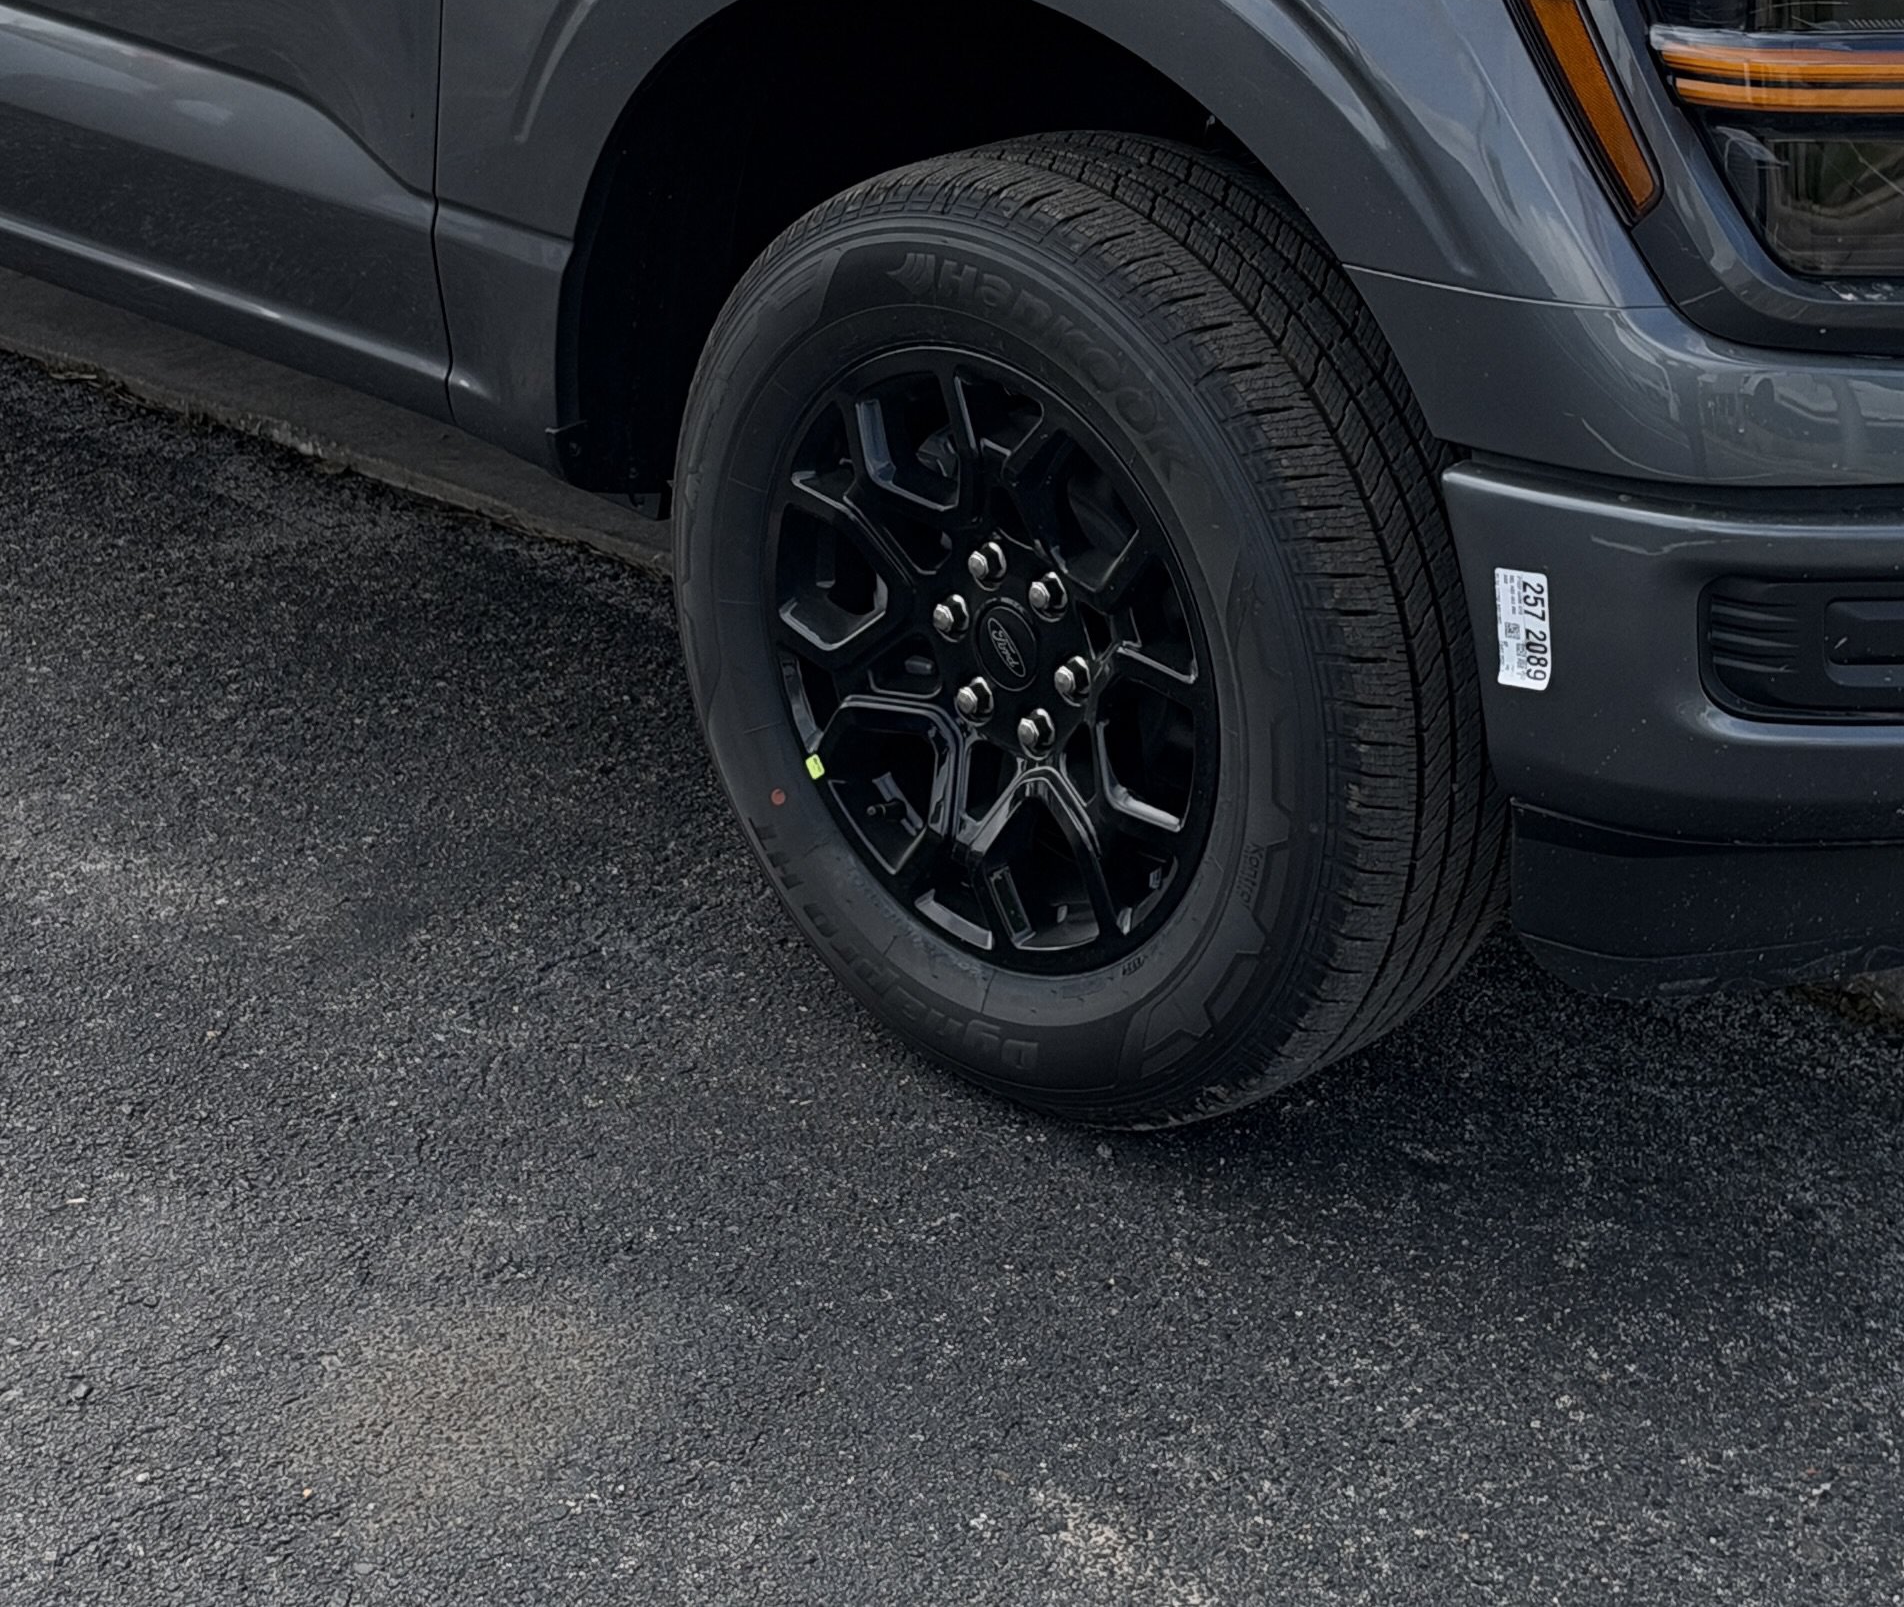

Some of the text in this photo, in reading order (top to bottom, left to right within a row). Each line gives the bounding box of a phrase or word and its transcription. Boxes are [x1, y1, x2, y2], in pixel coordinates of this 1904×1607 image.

[991, 629, 1019, 668] Ford
[1522, 581, 1549, 681] 257 2089
